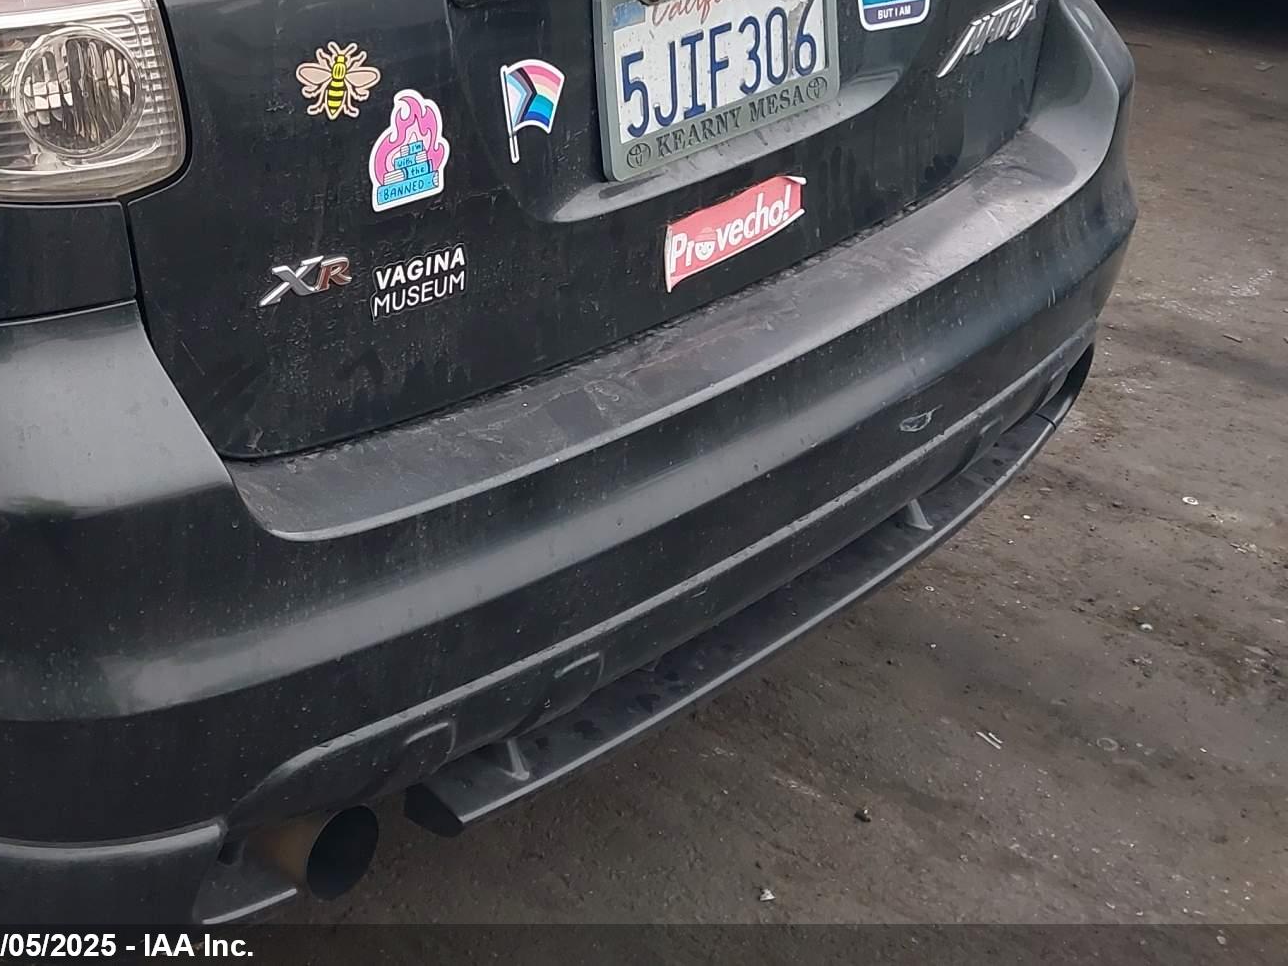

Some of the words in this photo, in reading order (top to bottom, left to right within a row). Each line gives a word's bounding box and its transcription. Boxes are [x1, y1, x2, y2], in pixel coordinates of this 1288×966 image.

[877, 8, 893, 19] BUT
[899, 5, 911, 16] AM
[656, 106, 743, 157] KEARNY
[749, 85, 805, 124] MESA
[383, 179, 424, 201] BANNED
[411, 166, 424, 175] the
[261, 255, 353, 306] XR
[376, 247, 465, 290] VAGINA
[374, 271, 465, 317] MUSEUM
